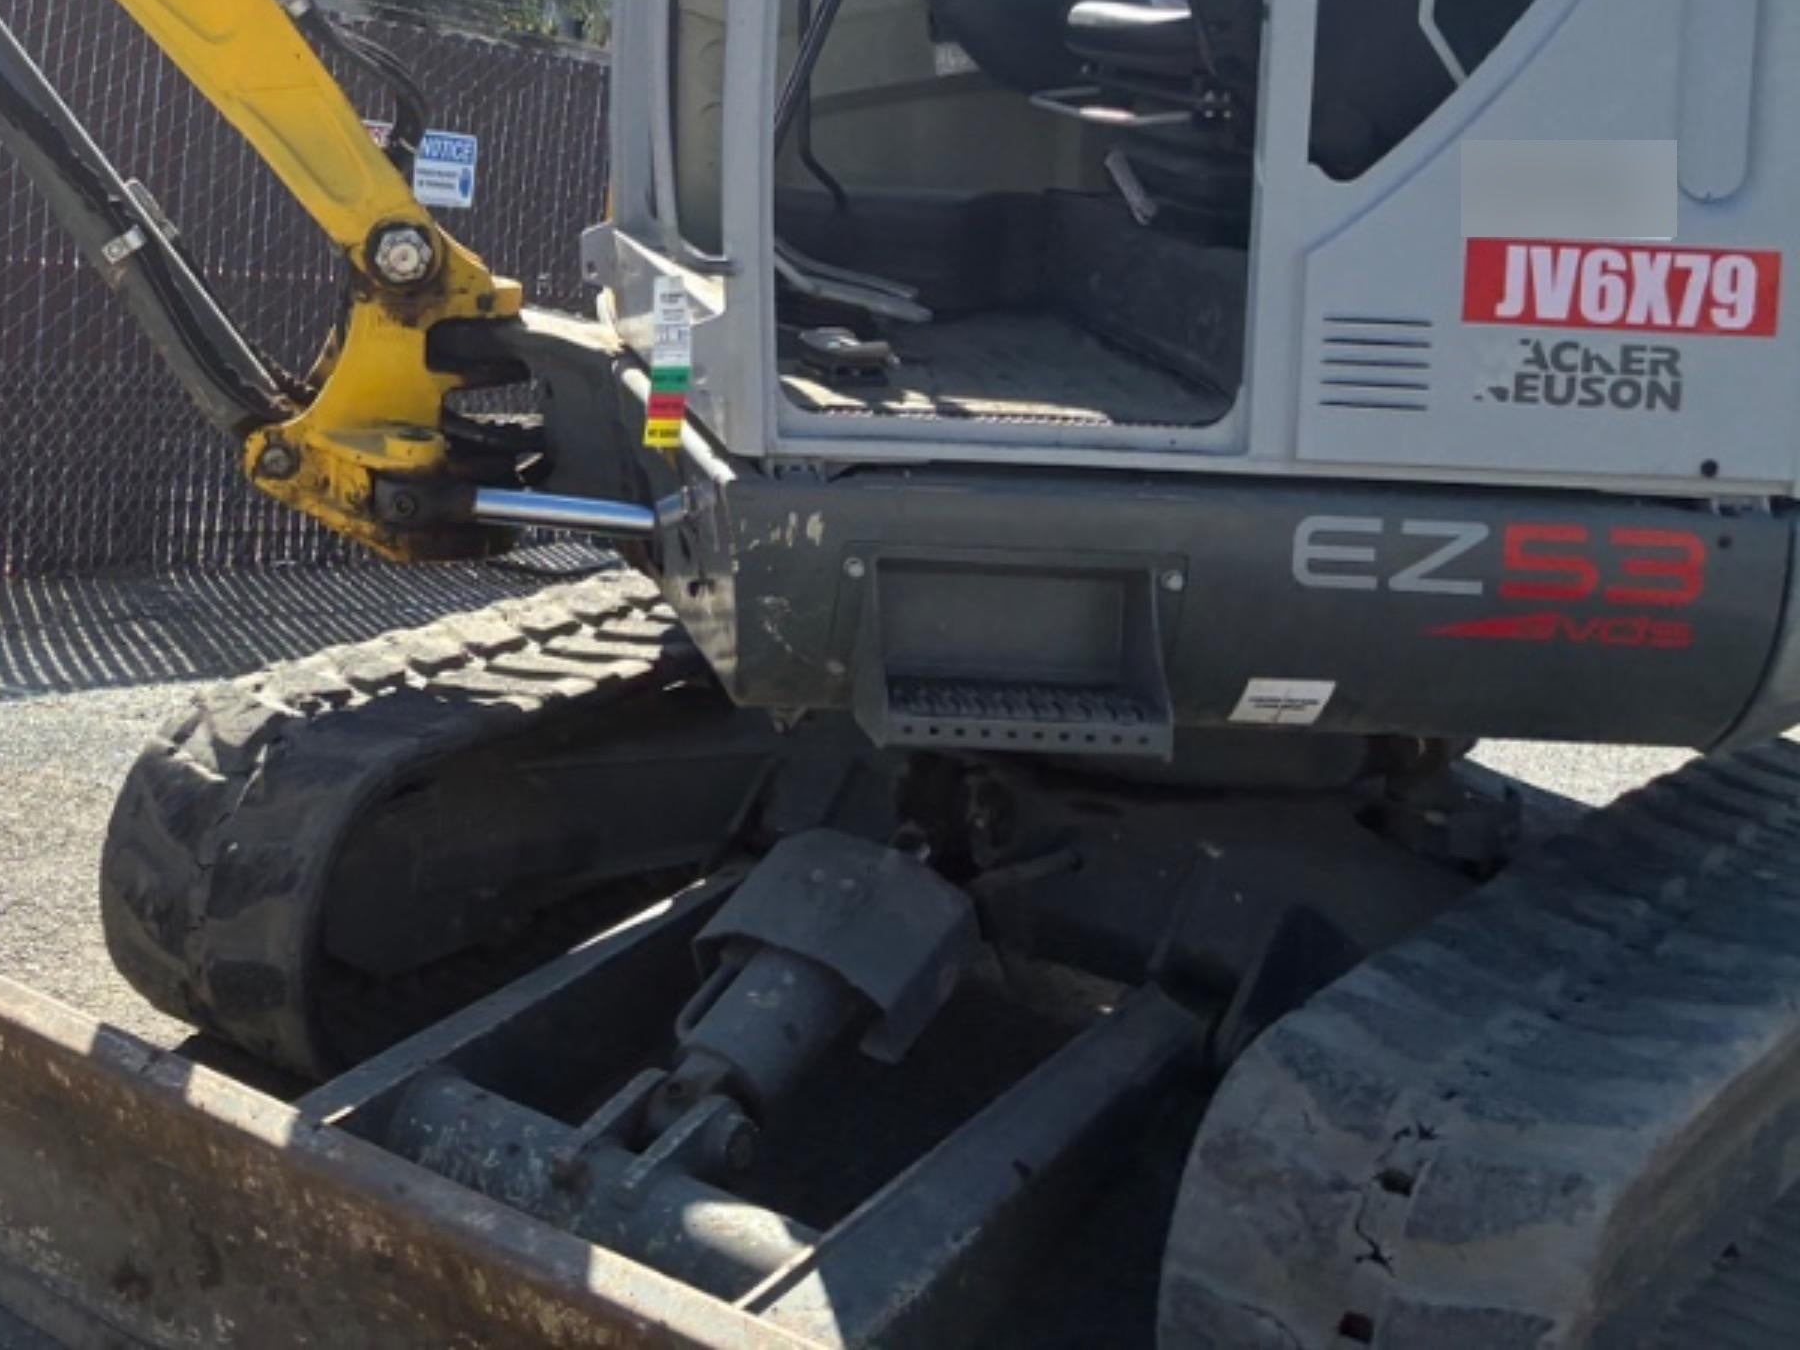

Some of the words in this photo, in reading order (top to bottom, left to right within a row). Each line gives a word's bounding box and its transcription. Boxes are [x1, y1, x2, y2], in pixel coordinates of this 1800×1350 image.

[423, 135, 473, 163] NOTICE
[1494, 244, 1758, 331] JV6X79
[1518, 337, 1683, 378] ACKER
[1473, 371, 1683, 412] EUSON
[1291, 514, 1706, 607] EZ53
